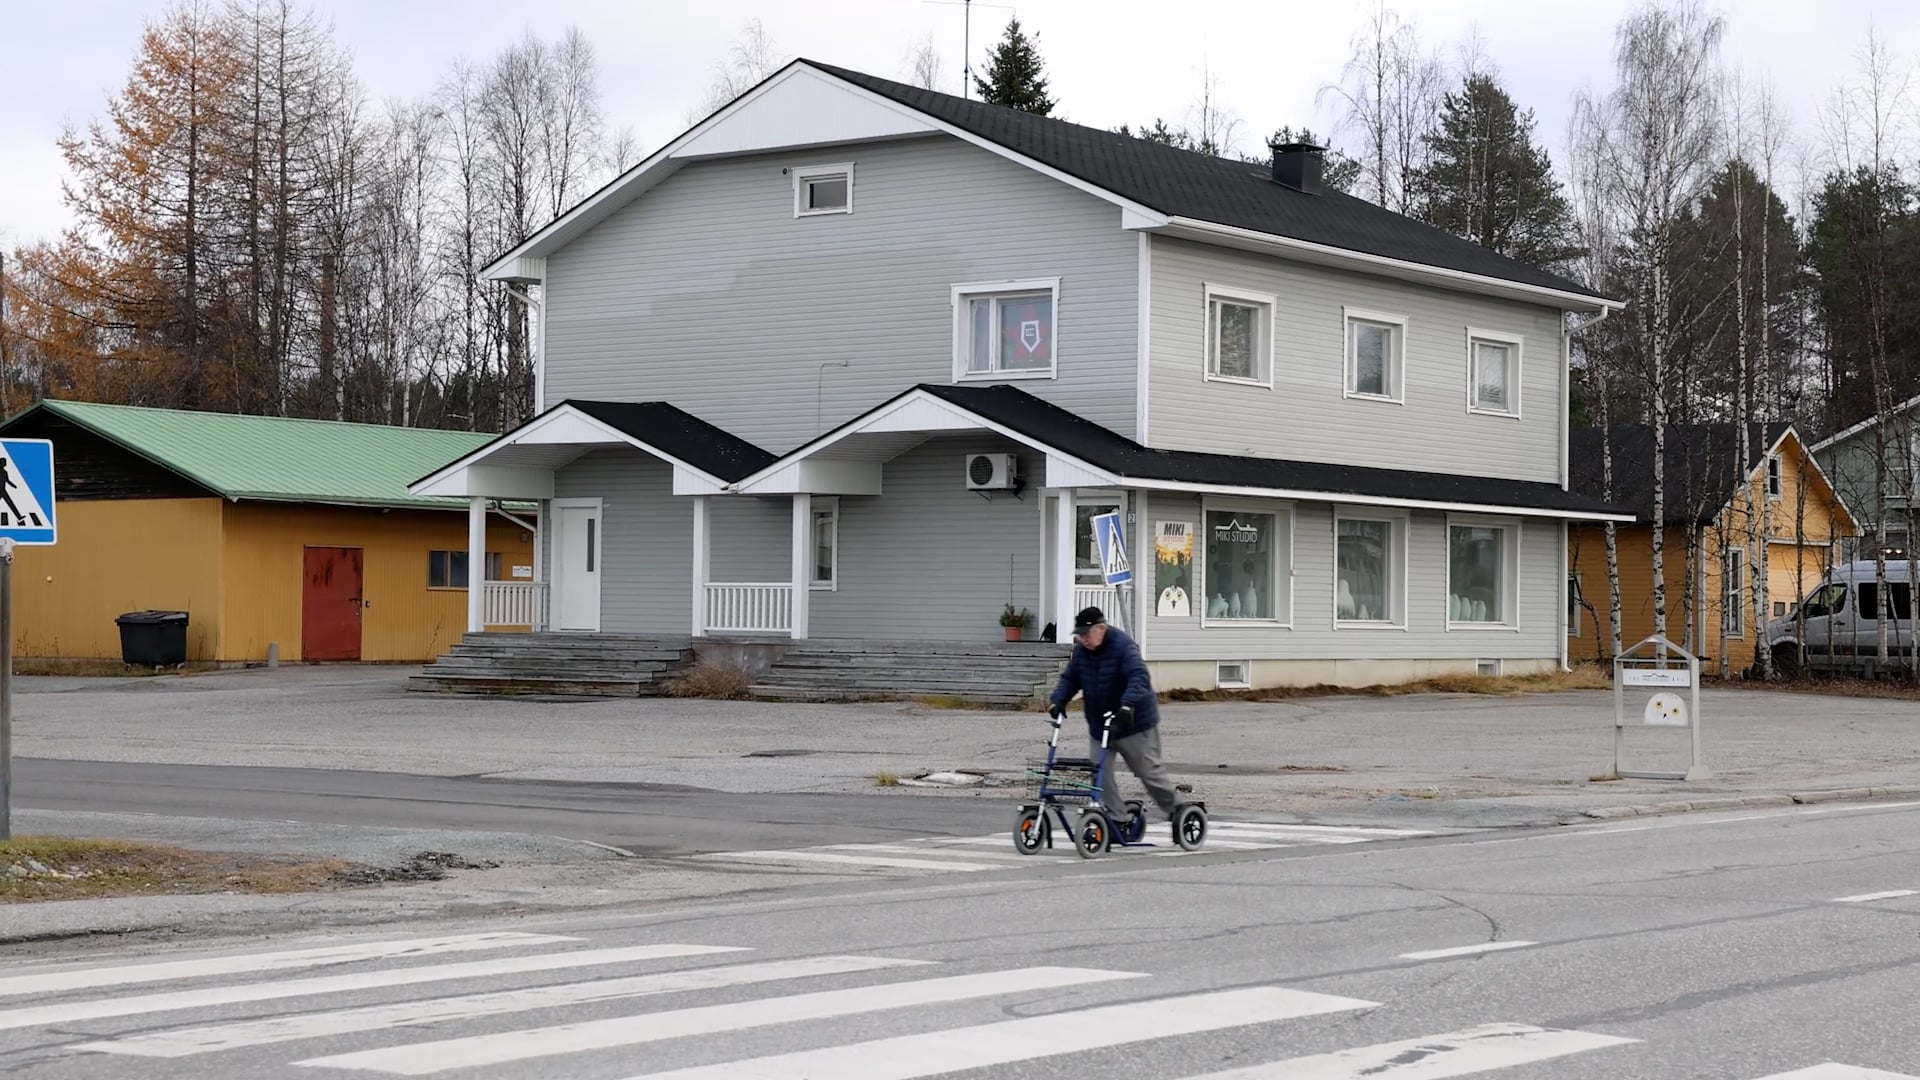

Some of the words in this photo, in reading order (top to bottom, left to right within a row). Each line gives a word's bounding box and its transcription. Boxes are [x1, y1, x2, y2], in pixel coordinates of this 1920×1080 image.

[1163, 523, 1185, 536] MIKI
[1215, 531, 1231, 541] MIKI
[1232, 531, 1258, 543] STUDIO
